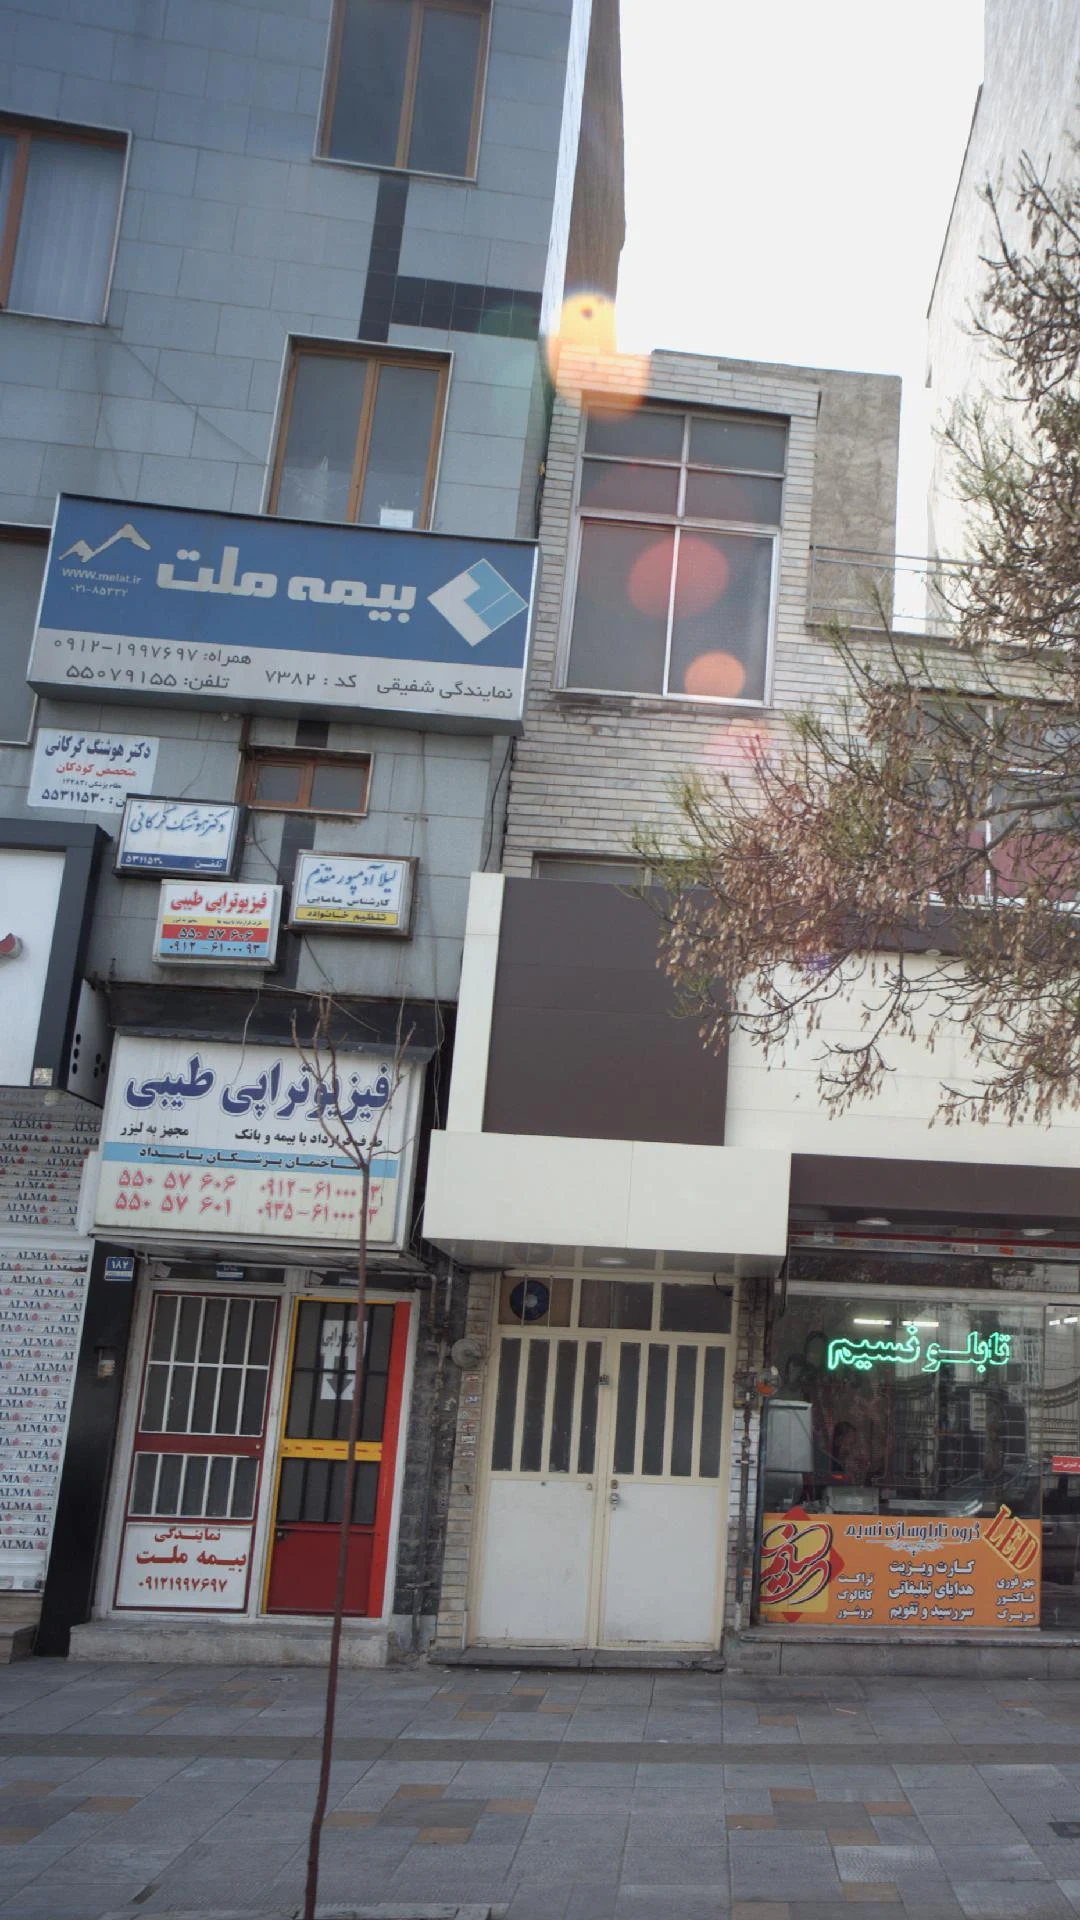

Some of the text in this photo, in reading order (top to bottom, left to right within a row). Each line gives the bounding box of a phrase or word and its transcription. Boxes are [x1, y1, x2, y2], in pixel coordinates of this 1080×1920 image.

[156, 545, 416, 624] بیمه ملت
[54, 637, 252, 667] همراه: ۰۹۱۲-۱۹۹۷۶۹۷
[66, 665, 230, 691] تلفن: ۵۵۰۷۹۱۵۵
[265, 669, 316, 687] ۷۳۸۲
[335, 674, 357, 688] کد
[377, 678, 435, 696] شفیقی
[439, 681, 513, 703] نمایندگی
[86, 739, 125, 762] هوشنگ
[125, 741, 151, 763] دکتر
[56, 762, 95, 776] کودکان
[205, 891, 268, 914] فیزیوتراپی
[346, 898, 390, 907] کارشناس
[178, 927, 202, 939] ۵۵۰
[207, 928, 225, 939] ۵۷
[221, 1058, 392, 1122] فیزیوتراپی
[120, 1121, 190, 1139] مجهز به لیزر
[234, 1128, 261, 1141] بانک
[265, 1133, 271, 1144] و
[299, 1132, 307, 1146] با
[273, 1133, 296, 1146] بیمه
[139, 1146, 203, 1161] بامداد
[118, 1167, 154, 1188] ۵۵۰
[163, 1170, 192, 1190] ۵۷
[200, 1172, 237, 1192] ۶۰۶
[115, 1191, 152, 1211] ۵۵۰
[161, 1193, 189, 1214] ۵۷
[199, 1196, 232, 1217] ۶۰۱
[828, 1324, 1011, 1373] تابلو نسیم
[155, 1527, 221, 1544] نمایندگی
[845, 1520, 980, 1543] گروه تابلوسازی نسیم
[983, 1506, 1039, 1571] LED
[136, 1545, 248, 1573] بیمه ملت
[888, 1559, 975, 1578] کارت ویزیت
[837, 1571, 875, 1587] تراکت
[996, 1575, 1036, 1591] مهر فوری
[888, 1580, 975, 1600] هدایای تبلیغاتی
[996, 1591, 1036, 1607] فاکتور
[836, 1605, 874, 1620] بروشور
[889, 1601, 975, 1621] سررسید و تقویم
